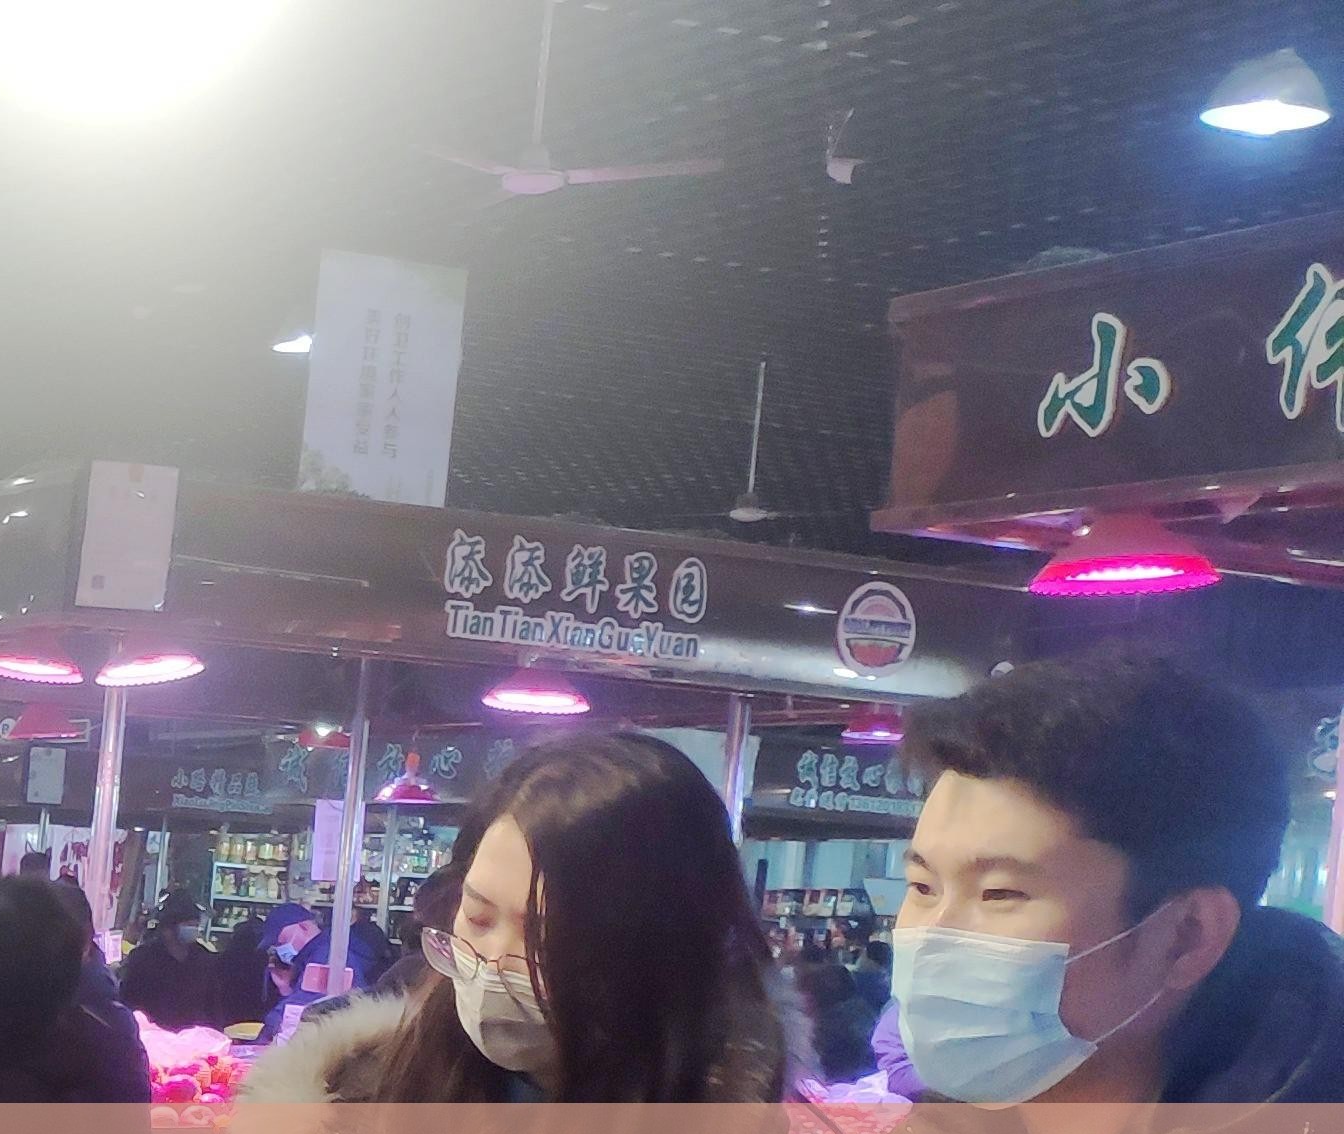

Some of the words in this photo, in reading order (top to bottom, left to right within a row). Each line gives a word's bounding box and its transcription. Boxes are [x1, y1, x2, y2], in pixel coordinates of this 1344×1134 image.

[443, 528, 709, 624] 添添鲜果园
